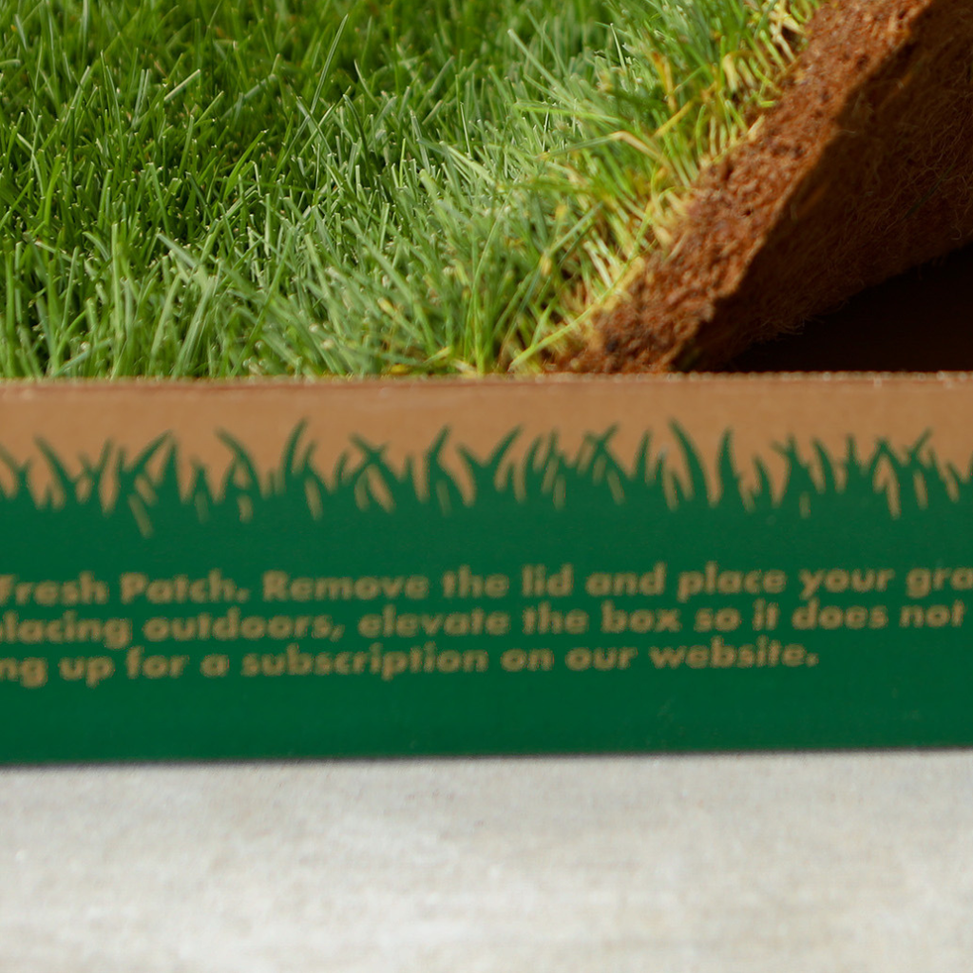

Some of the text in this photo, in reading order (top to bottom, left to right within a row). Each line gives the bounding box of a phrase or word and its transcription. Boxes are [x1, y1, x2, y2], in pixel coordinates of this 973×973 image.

[120, 569, 248, 605] Patch.
[263, 569, 429, 601] Remove
[443, 564, 509, 598] the
[521, 562, 574, 597] lid
[586, 561, 667, 596] and
[677, 560, 787, 602] place
[798, 567, 895, 600] your
[0, 598, 966, 650] lacing outdoors, elevate the box so it does not
[58, 656, 115, 688] up
[126, 645, 189, 679] for
[199, 653, 230, 677] a
[241, 642, 489, 681] subscription
[500, 649, 554, 672] on
[565, 646, 638, 671] our
[649, 634, 819, 669] website.
